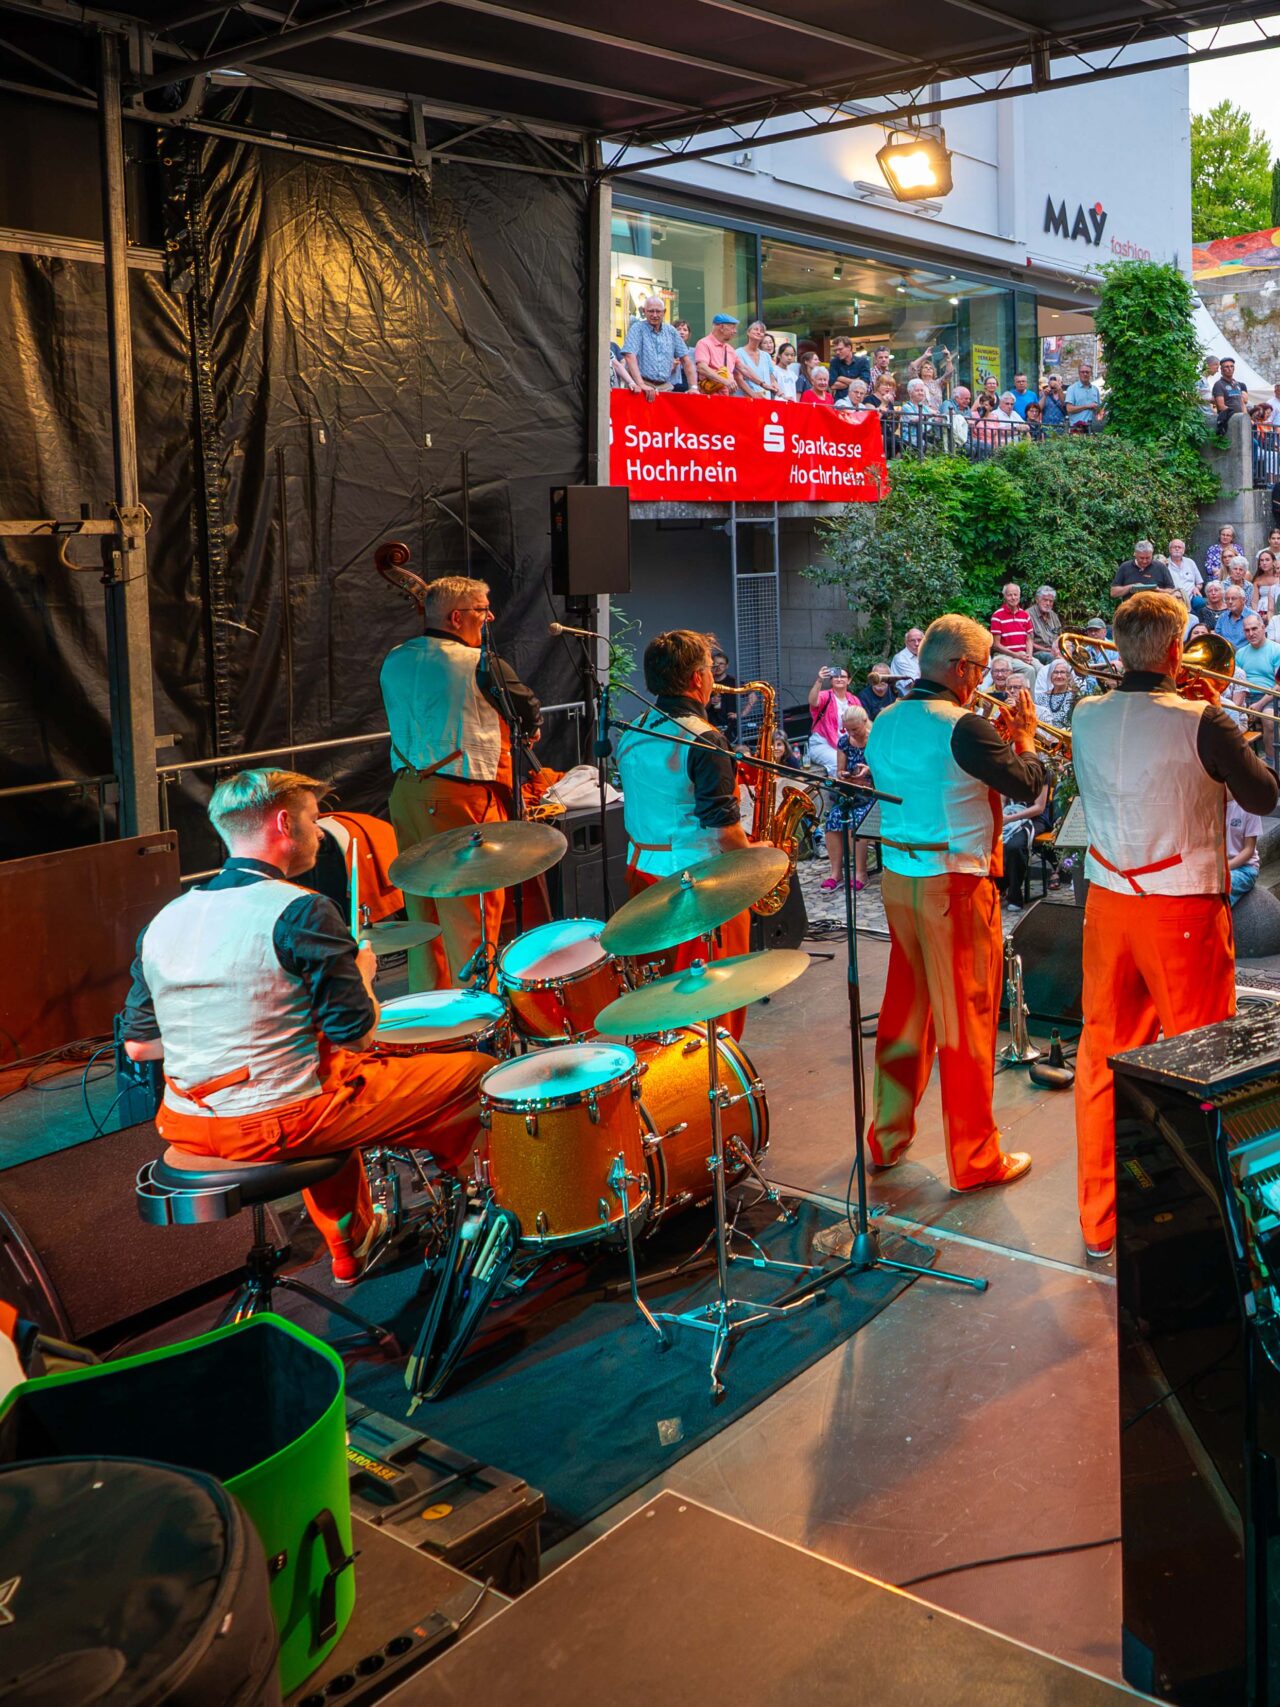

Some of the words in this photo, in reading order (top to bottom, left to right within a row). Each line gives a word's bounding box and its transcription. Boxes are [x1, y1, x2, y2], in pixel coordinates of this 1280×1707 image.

[1044, 193, 1107, 247] MAY
[1111, 236, 1151, 261] fashion
[624, 425, 736, 452] Sparkasse
[791, 433, 862, 458] Sparkasse
[626, 458, 737, 483] Hochrhein
[789, 464, 865, 486] Hochrhein
